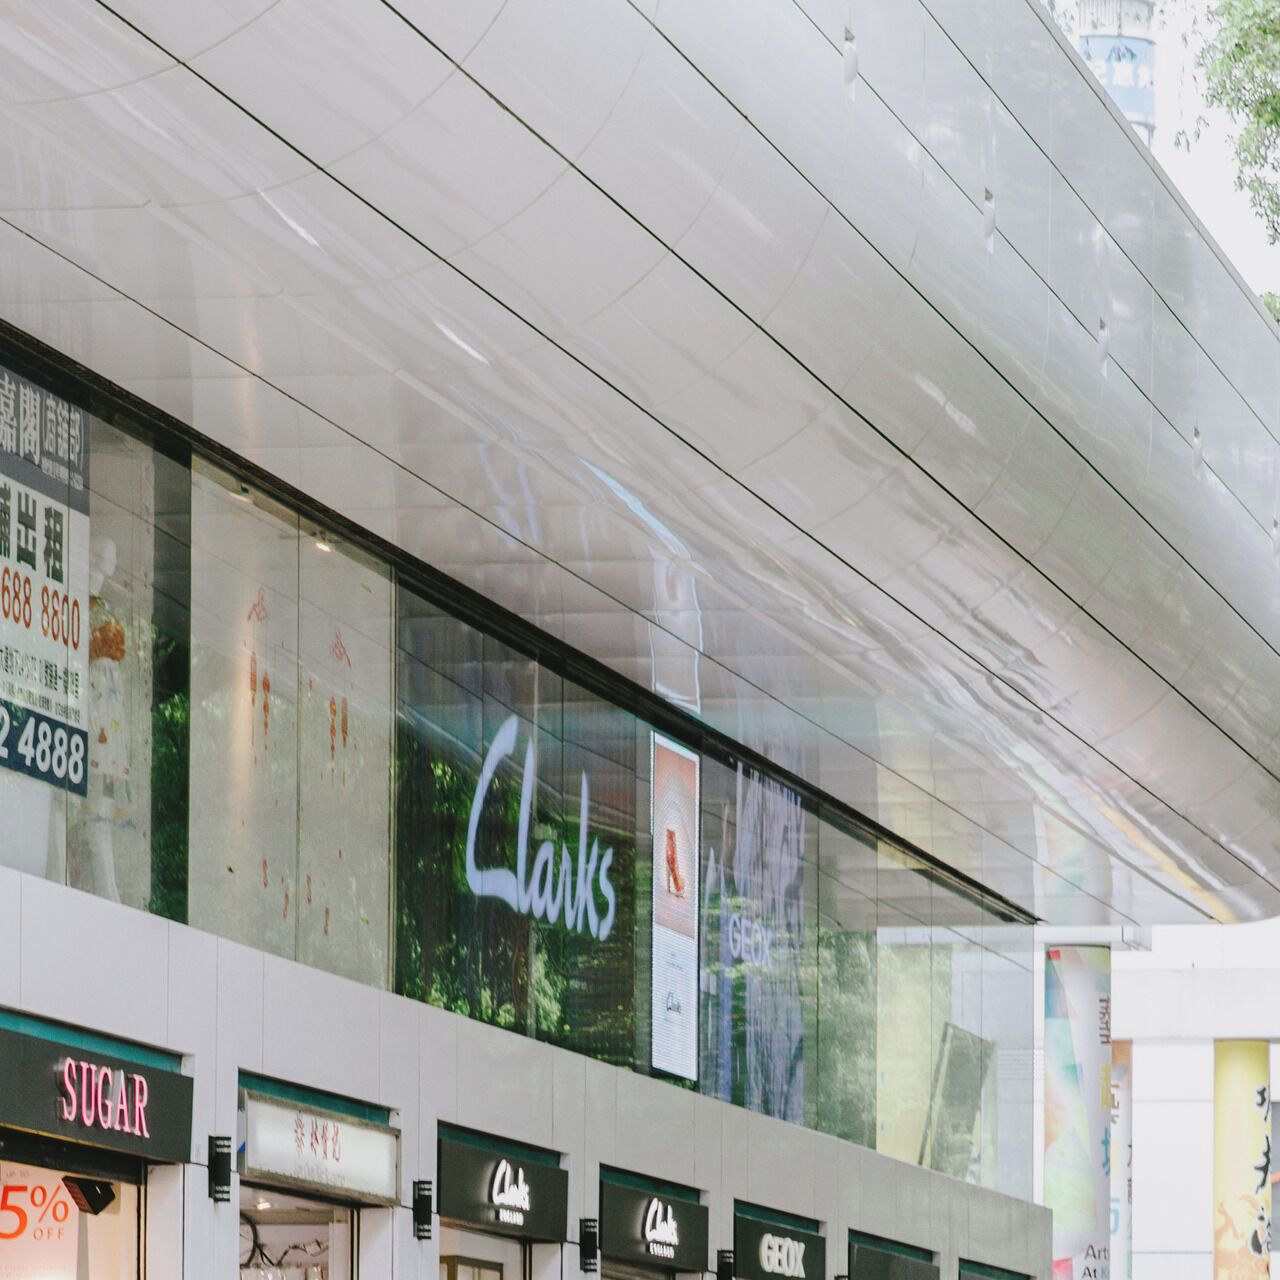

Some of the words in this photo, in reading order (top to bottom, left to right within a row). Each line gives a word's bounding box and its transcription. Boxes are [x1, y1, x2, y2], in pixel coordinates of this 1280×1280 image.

[18, 716, 85, 785] 4888
[465, 714, 617, 942] Clarks
[729, 912, 771, 968] GEOX
[62, 1056, 151, 1139] SUGAR
[32, 1226, 65, 1241] OFF
[759, 1233, 806, 1279] GEOX
[1081, 1266, 1098, 1280] At
